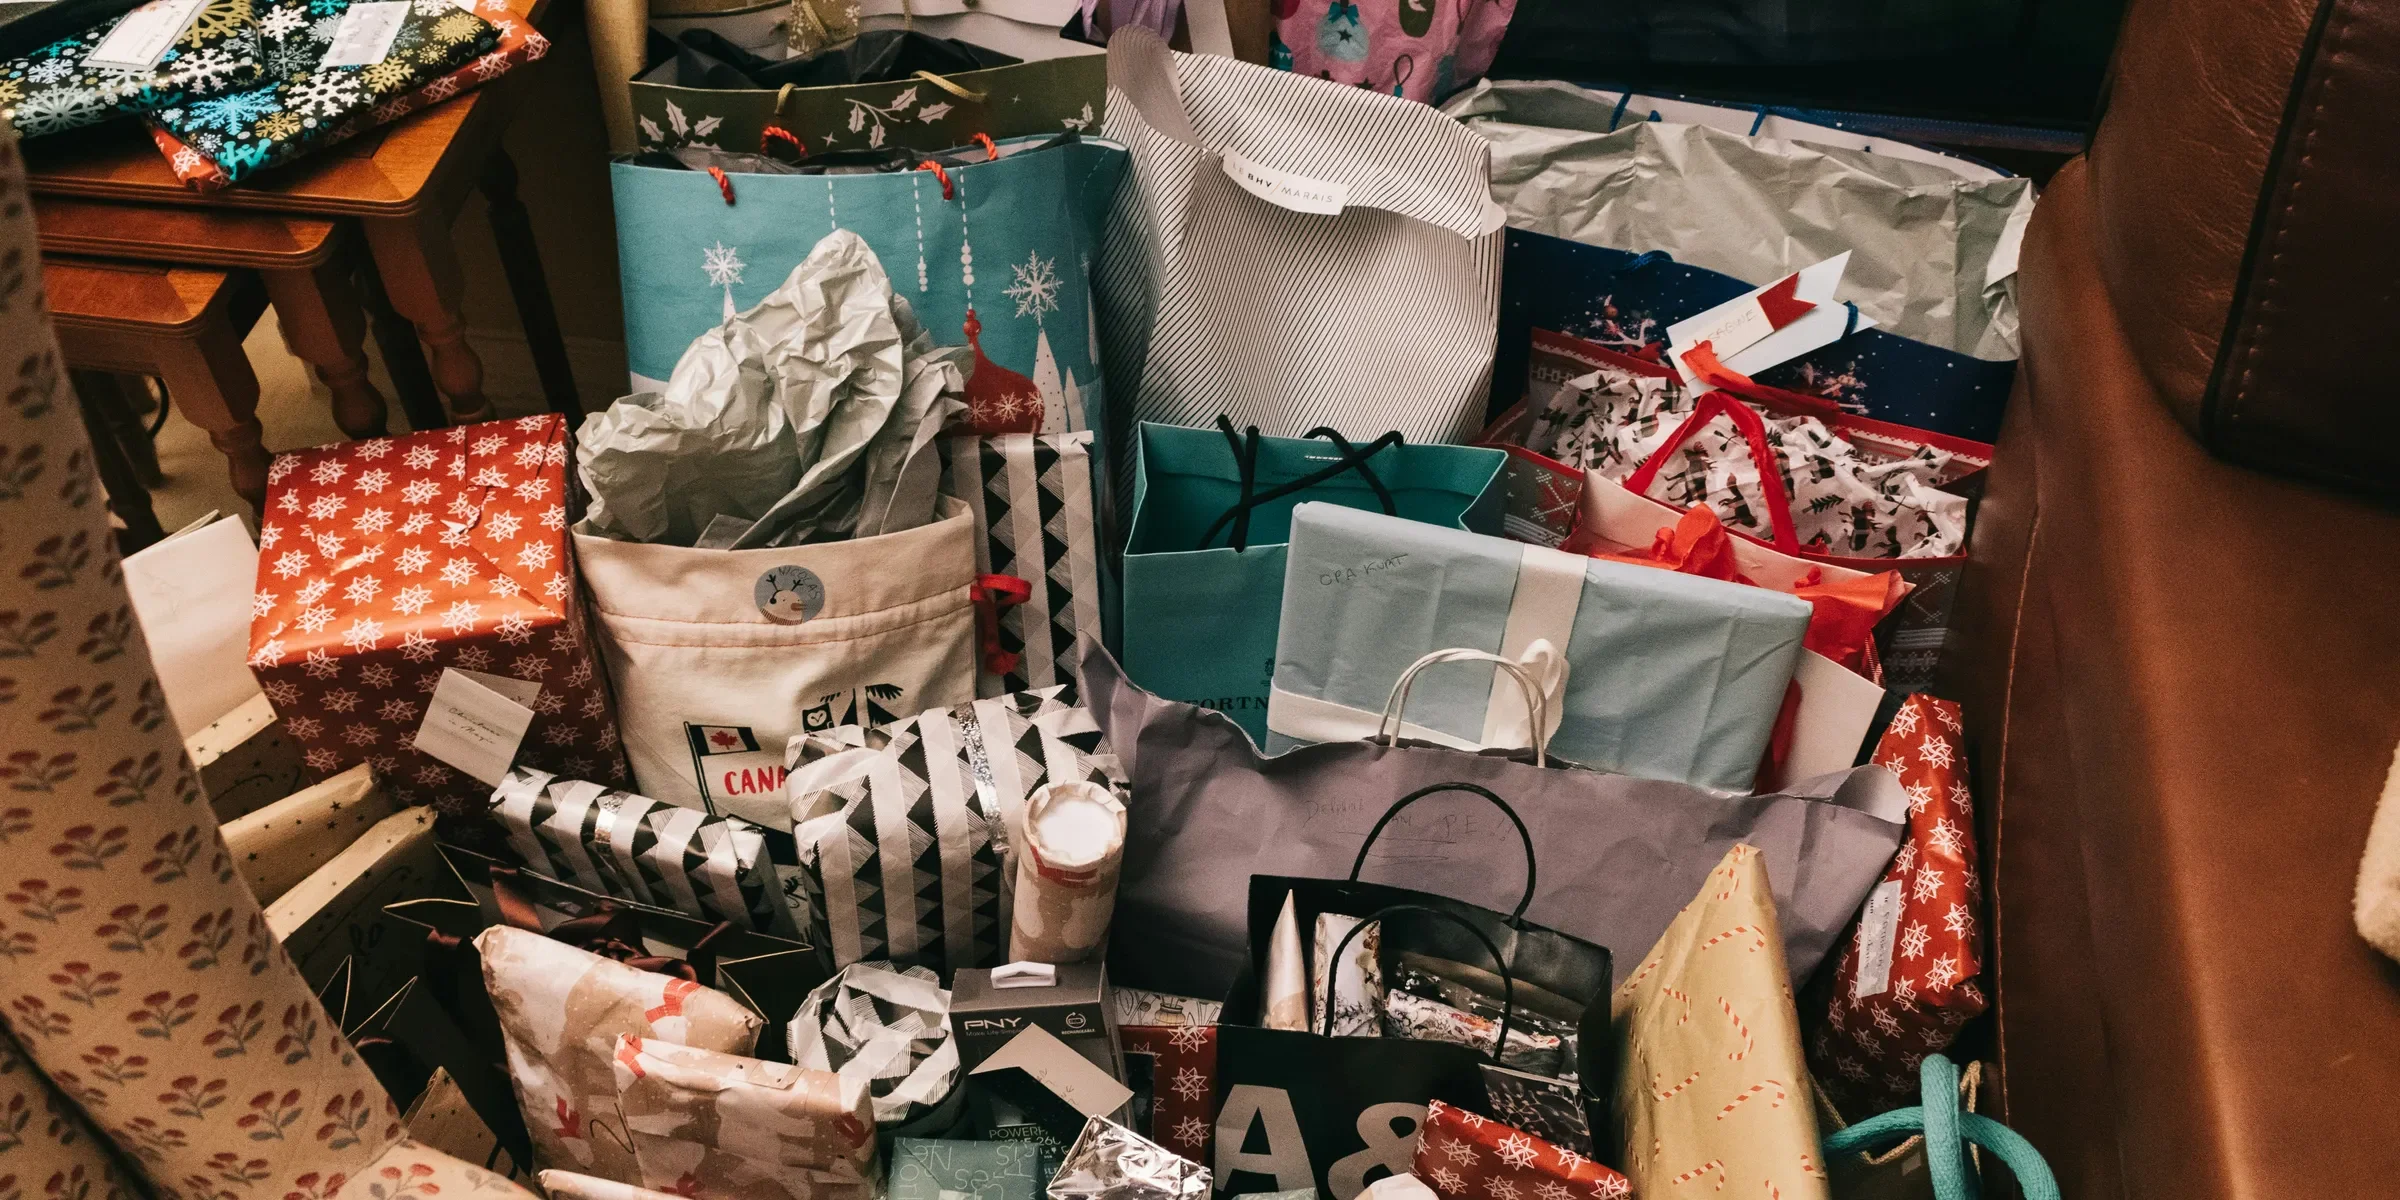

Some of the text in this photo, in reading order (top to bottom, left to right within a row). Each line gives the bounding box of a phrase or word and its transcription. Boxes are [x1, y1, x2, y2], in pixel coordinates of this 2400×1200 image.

[778, 565, 822, 600] NICOLAS
[1320, 568, 1357, 586] OPA
[1184, 696, 1268, 711] ORTN
[964, 1017, 1022, 1030] PNY
